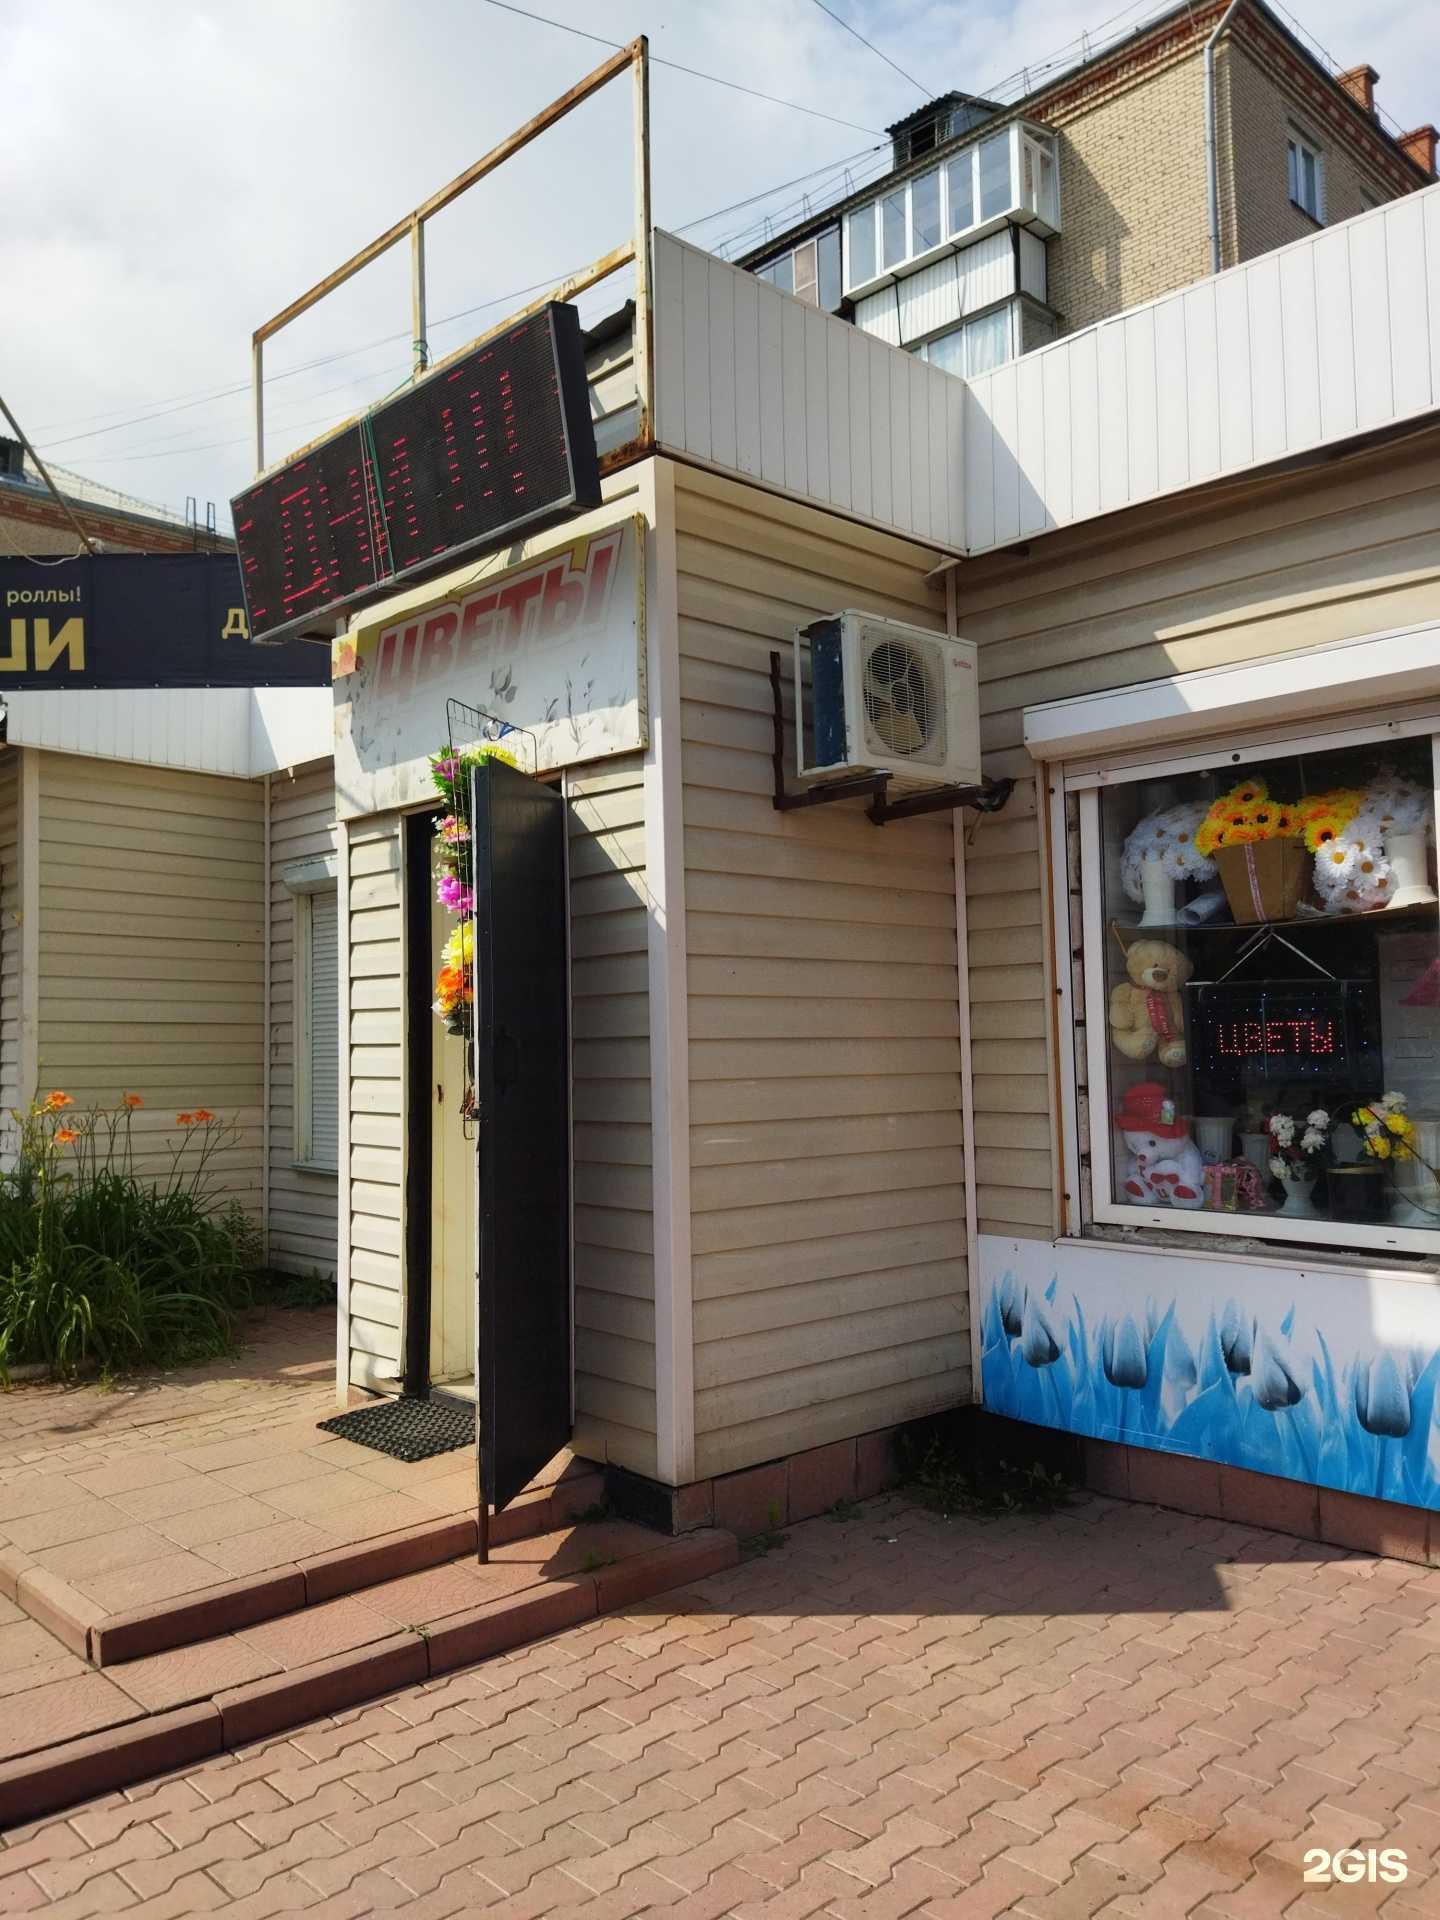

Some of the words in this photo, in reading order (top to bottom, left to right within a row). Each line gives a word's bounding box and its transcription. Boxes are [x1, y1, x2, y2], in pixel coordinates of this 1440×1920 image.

[7, 585, 81, 607] роллы!
[371, 538, 618, 700] ЦВЕТЫ
[1218, 1021, 1333, 1057] ЦВЕТЫ
